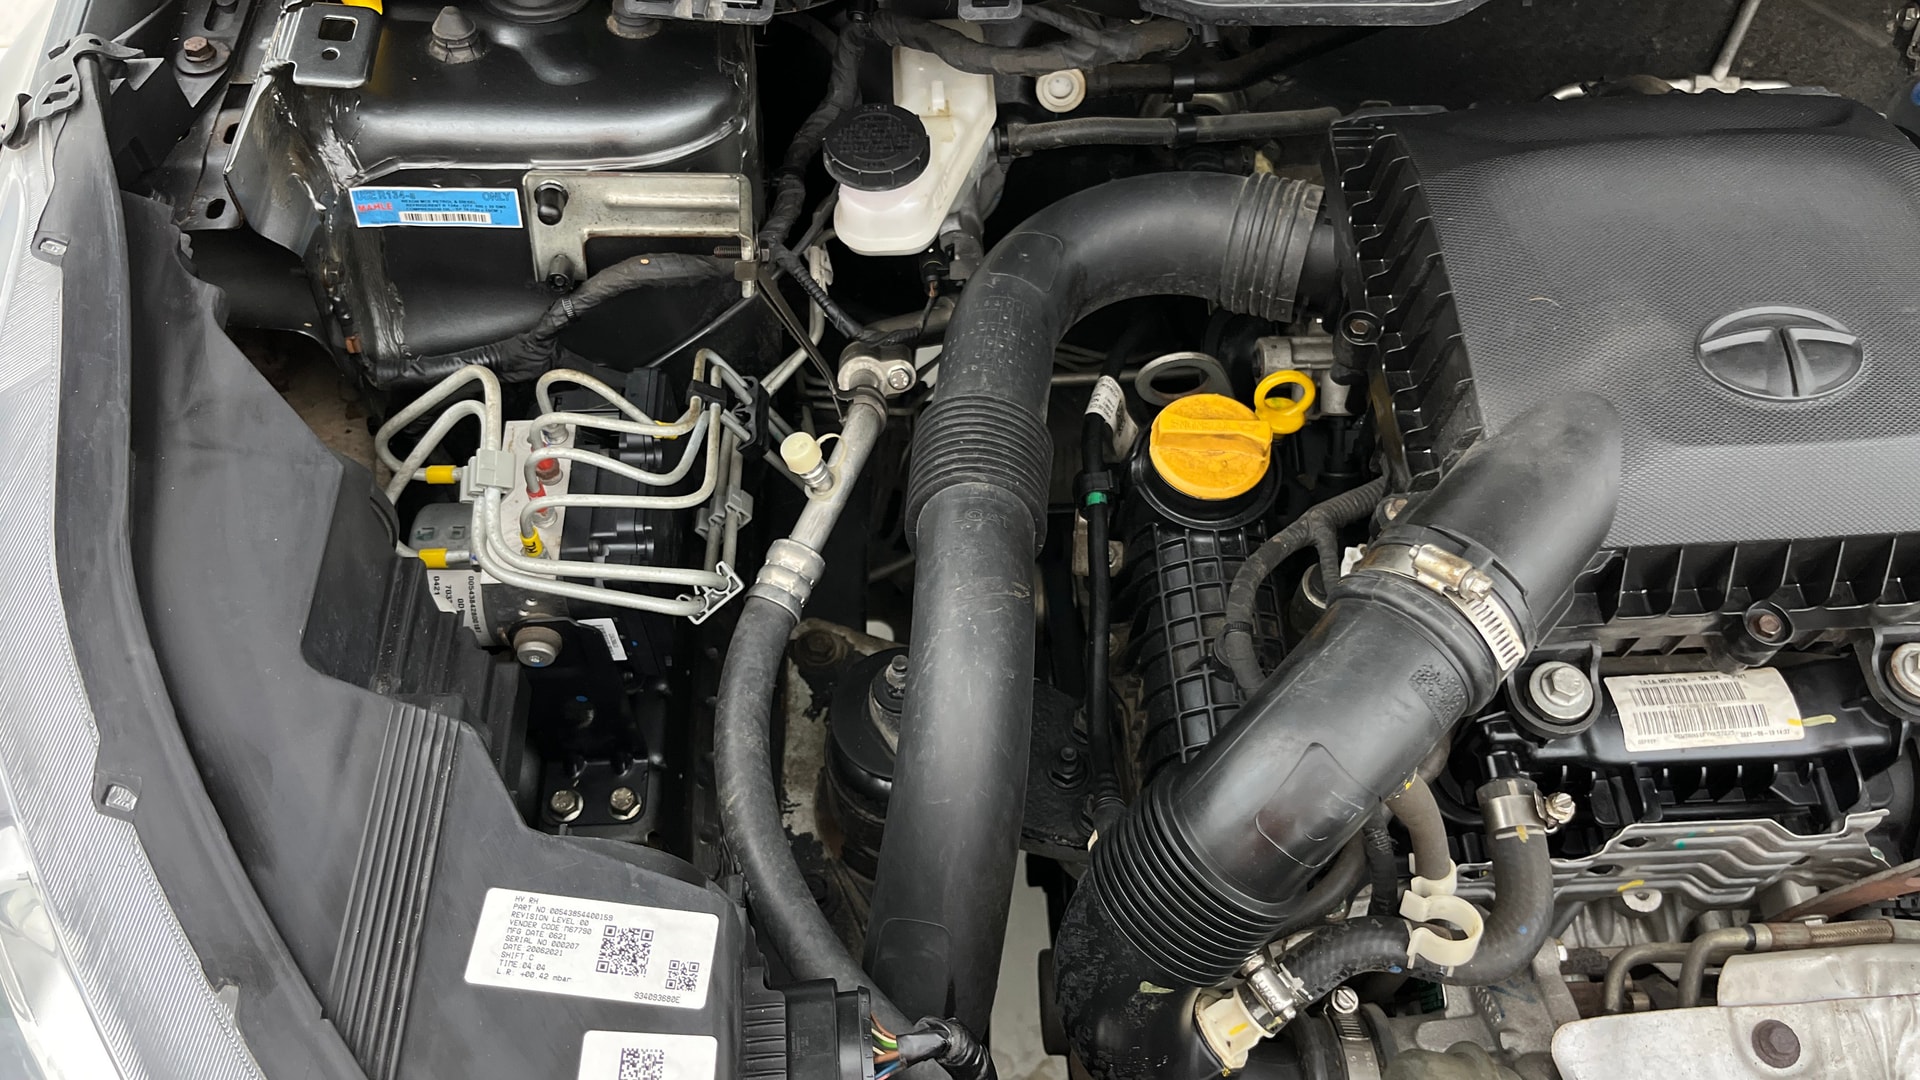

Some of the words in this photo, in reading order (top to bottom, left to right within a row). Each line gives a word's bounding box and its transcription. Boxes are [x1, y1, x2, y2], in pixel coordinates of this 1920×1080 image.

[482, 191, 511, 201] ONLY
[357, 202, 392, 212] MAHLE
[433, 575, 441, 596] 0421
[513, 903, 532, 911] PART
[511, 911, 549, 921] REVISION
[509, 919, 538, 929] VENDER
[506, 926, 522, 935] MFG
[525, 929, 545, 938] DATE
[505, 935, 532, 945] SERIAL
[552, 975, 572, 983] mbar
